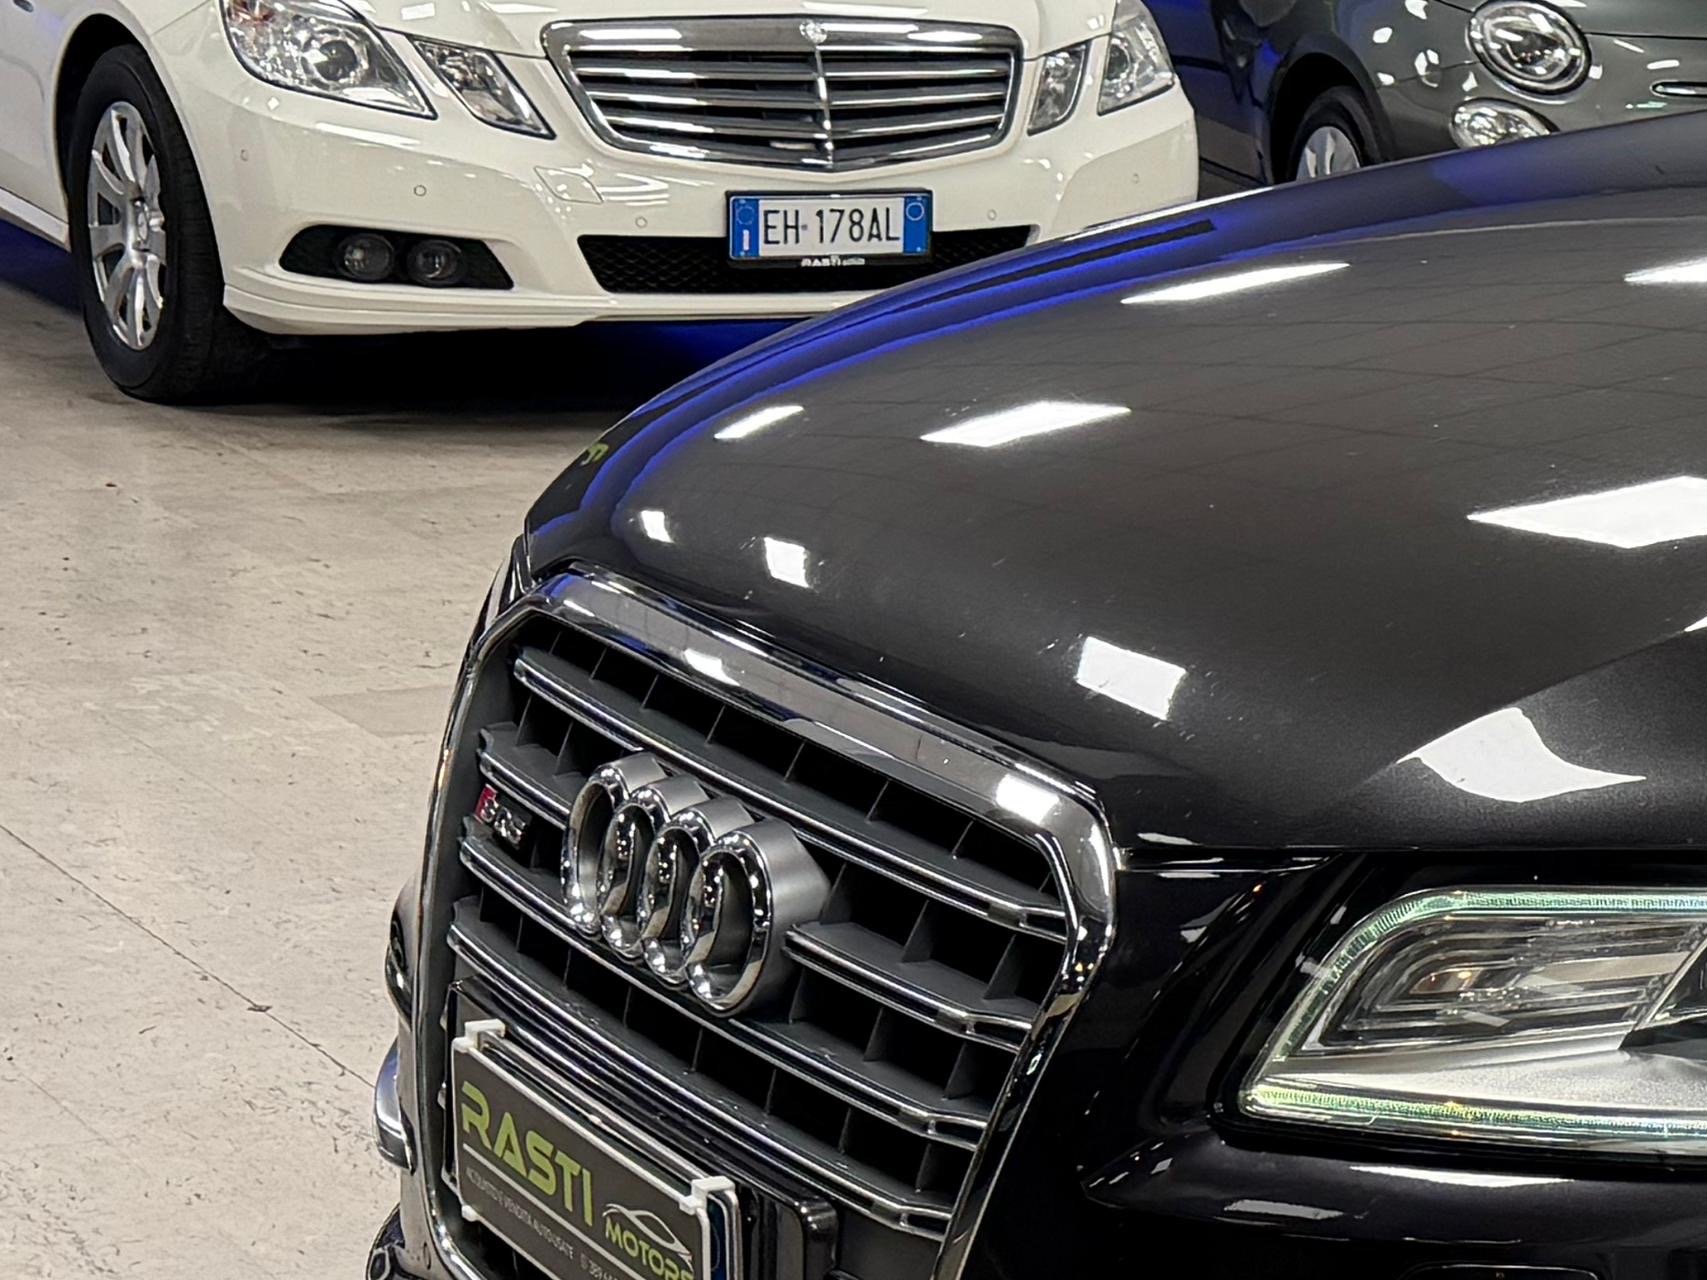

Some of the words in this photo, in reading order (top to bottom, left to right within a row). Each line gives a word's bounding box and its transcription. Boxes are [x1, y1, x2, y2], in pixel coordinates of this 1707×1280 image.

[763, 209, 799, 244] EH
[816, 207, 900, 243] 178AL
[462, 1080, 593, 1227] RASTI
